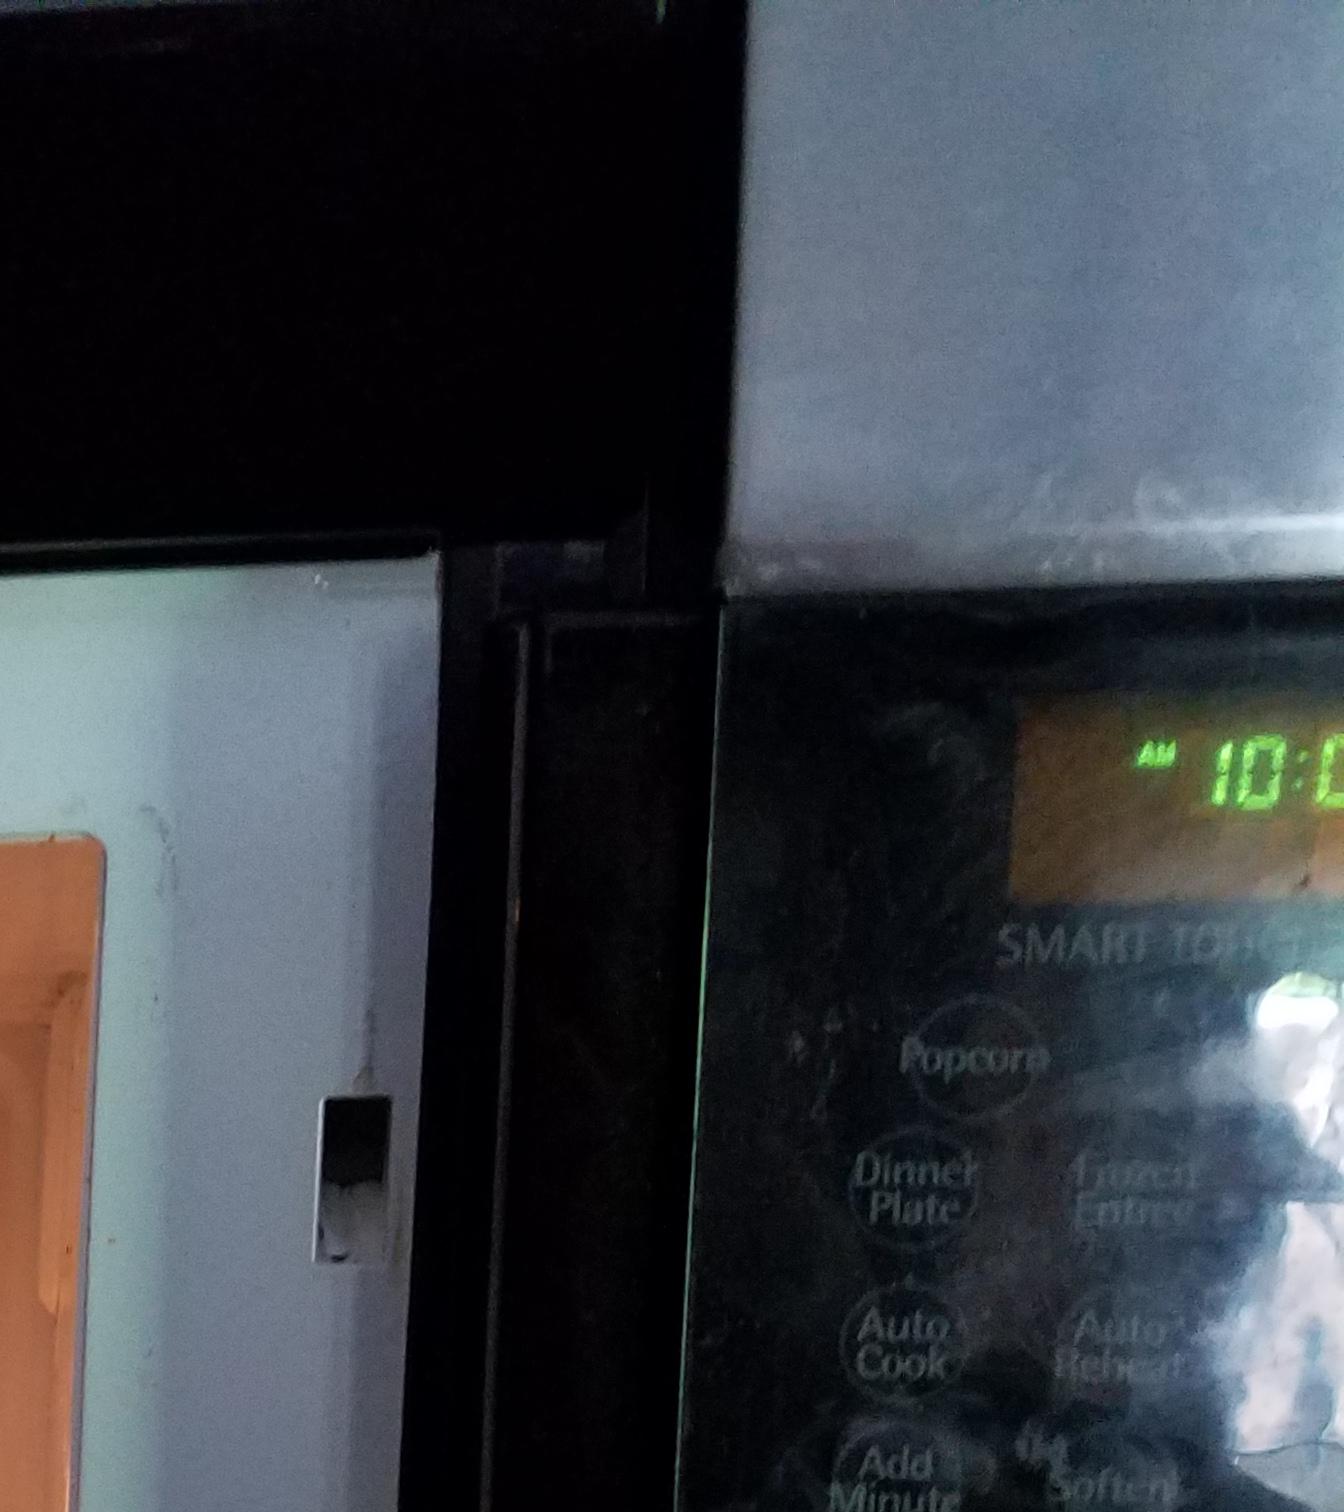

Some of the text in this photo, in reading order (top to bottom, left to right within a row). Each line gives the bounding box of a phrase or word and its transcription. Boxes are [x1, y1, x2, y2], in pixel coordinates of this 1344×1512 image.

[998, 923, 1146, 963] SMART
[898, 1036, 1051, 1084] Popcorn
[851, 1150, 977, 1191] Dinner
[869, 1189, 962, 1226] Plate
[857, 1306, 951, 1343] Auto
[857, 1347, 948, 1382] Cook
[858, 1444, 935, 1481] Add
